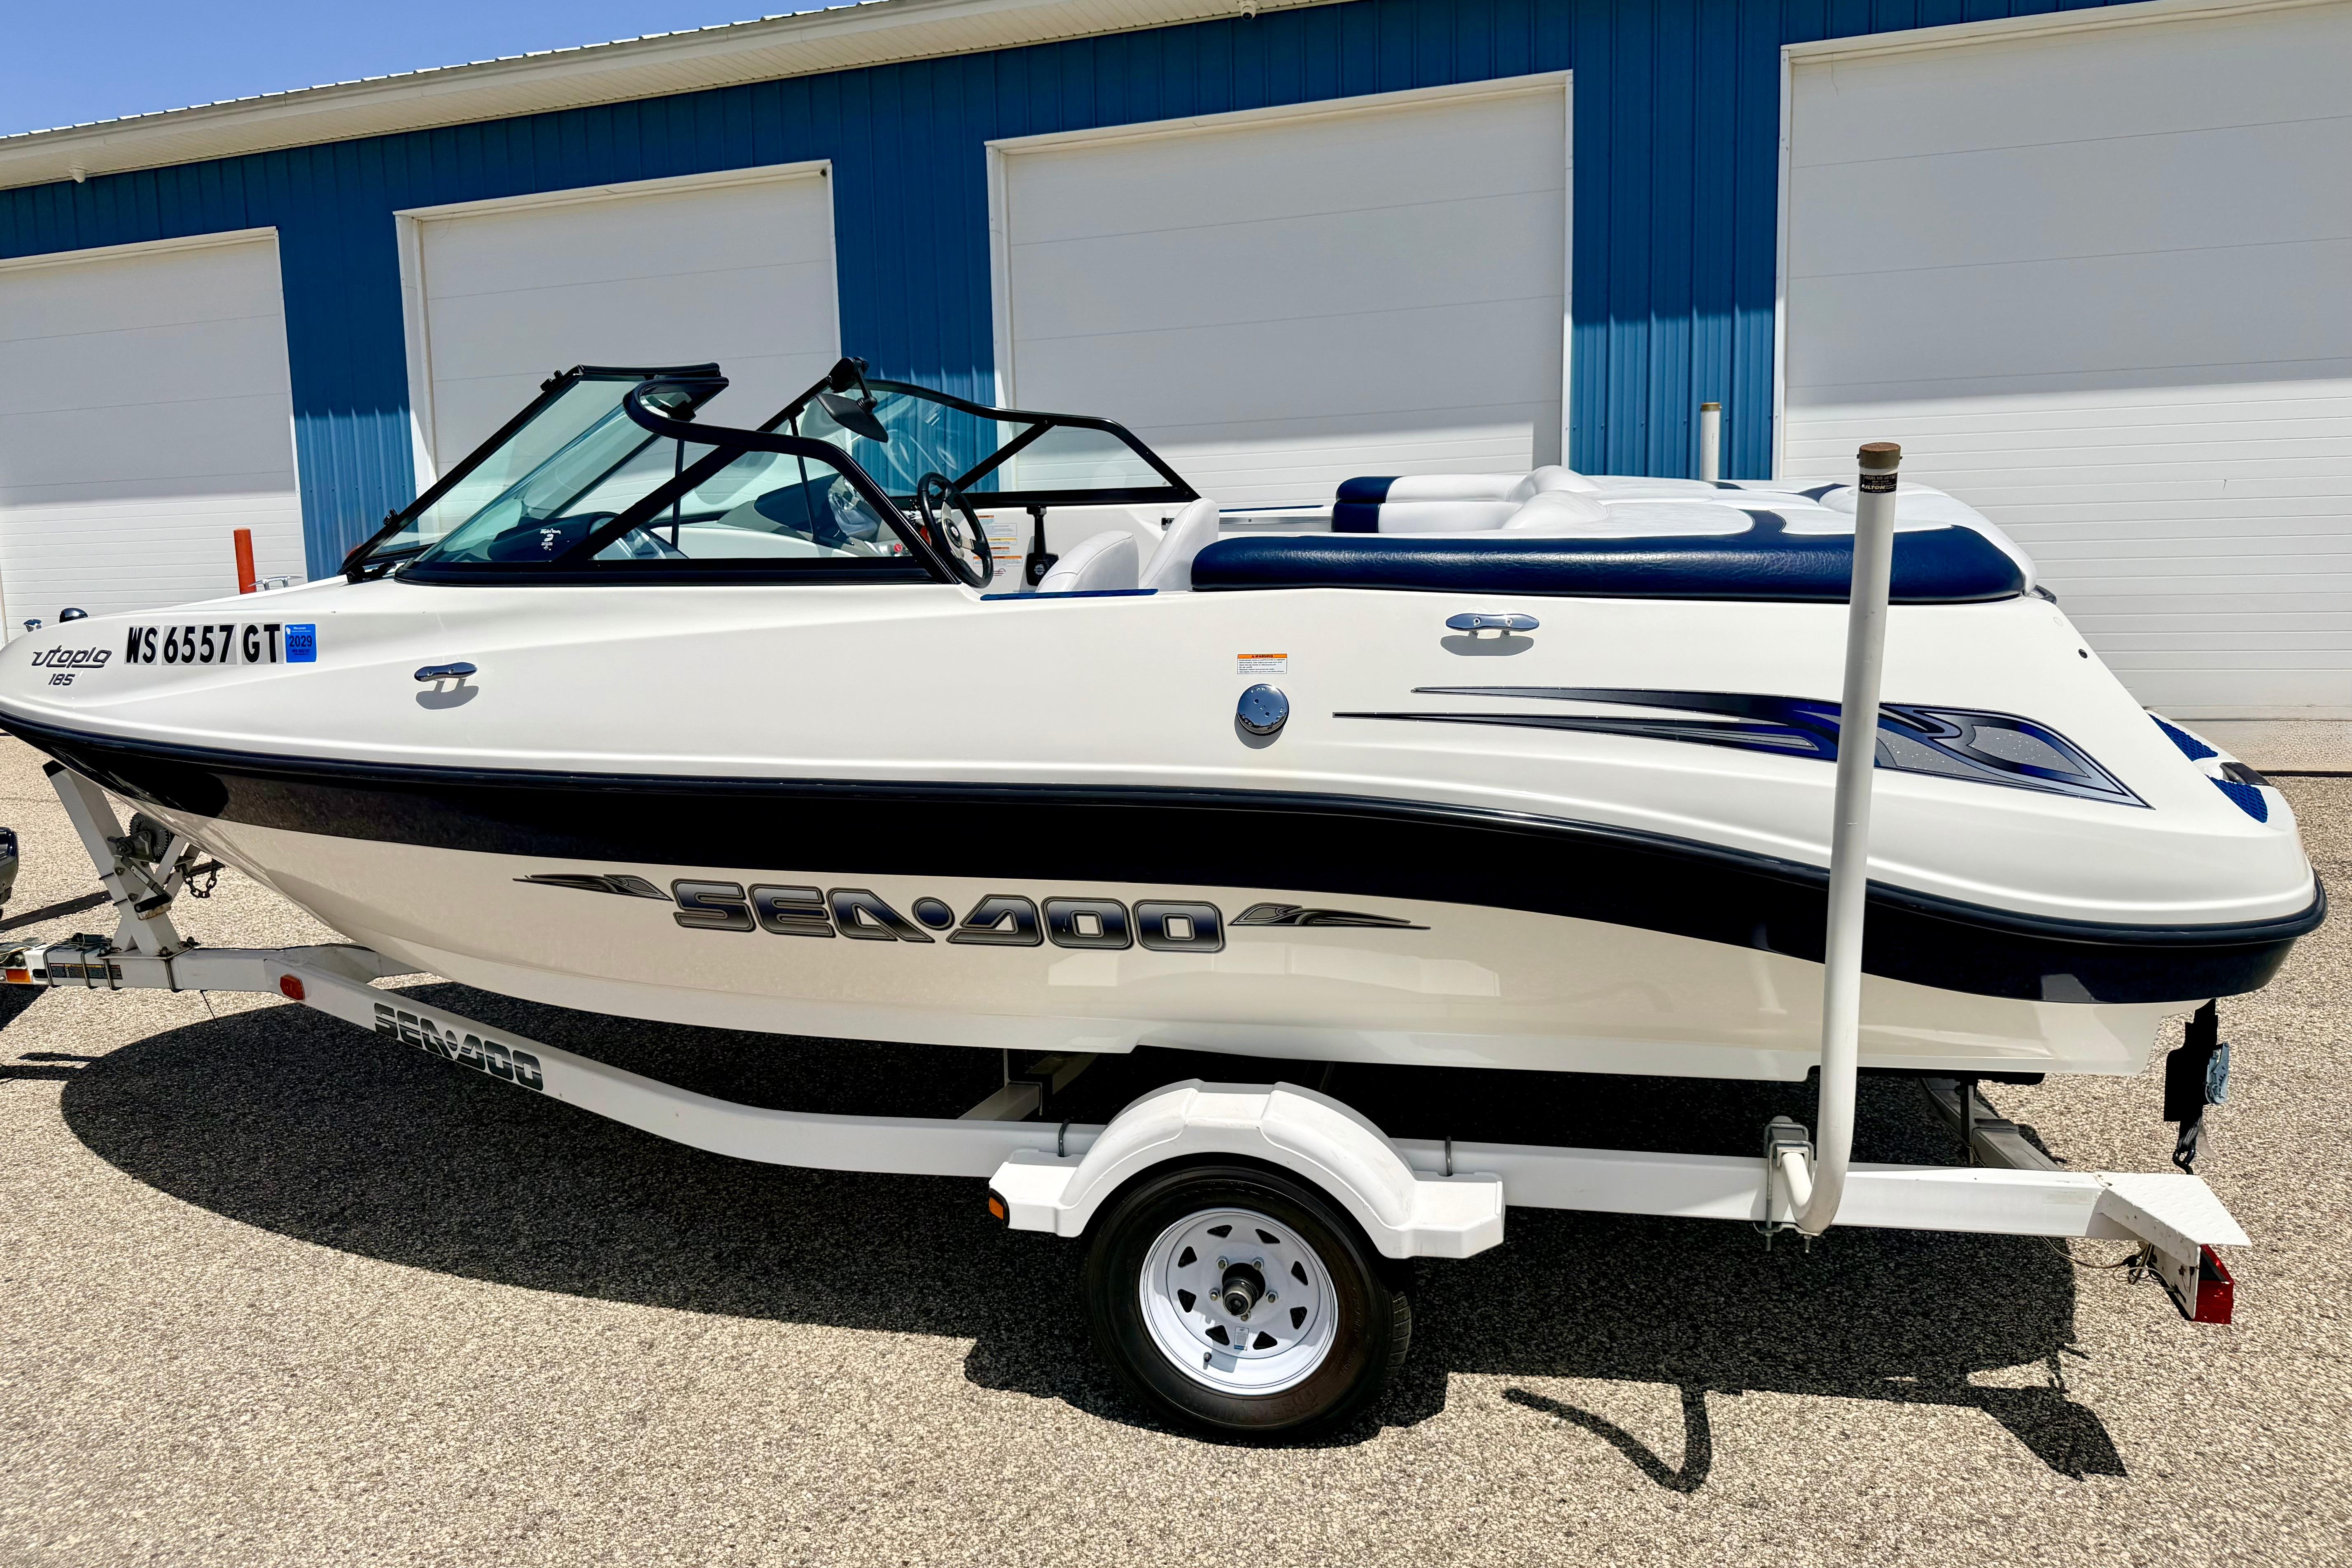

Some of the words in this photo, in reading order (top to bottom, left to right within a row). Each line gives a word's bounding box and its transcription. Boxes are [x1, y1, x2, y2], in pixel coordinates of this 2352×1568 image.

[126, 627, 158, 663] WS
[163, 625, 235, 663] 6557
[243, 624, 280, 663] GT
[289, 635, 312, 647] 2029
[48, 674, 76, 686] 185
